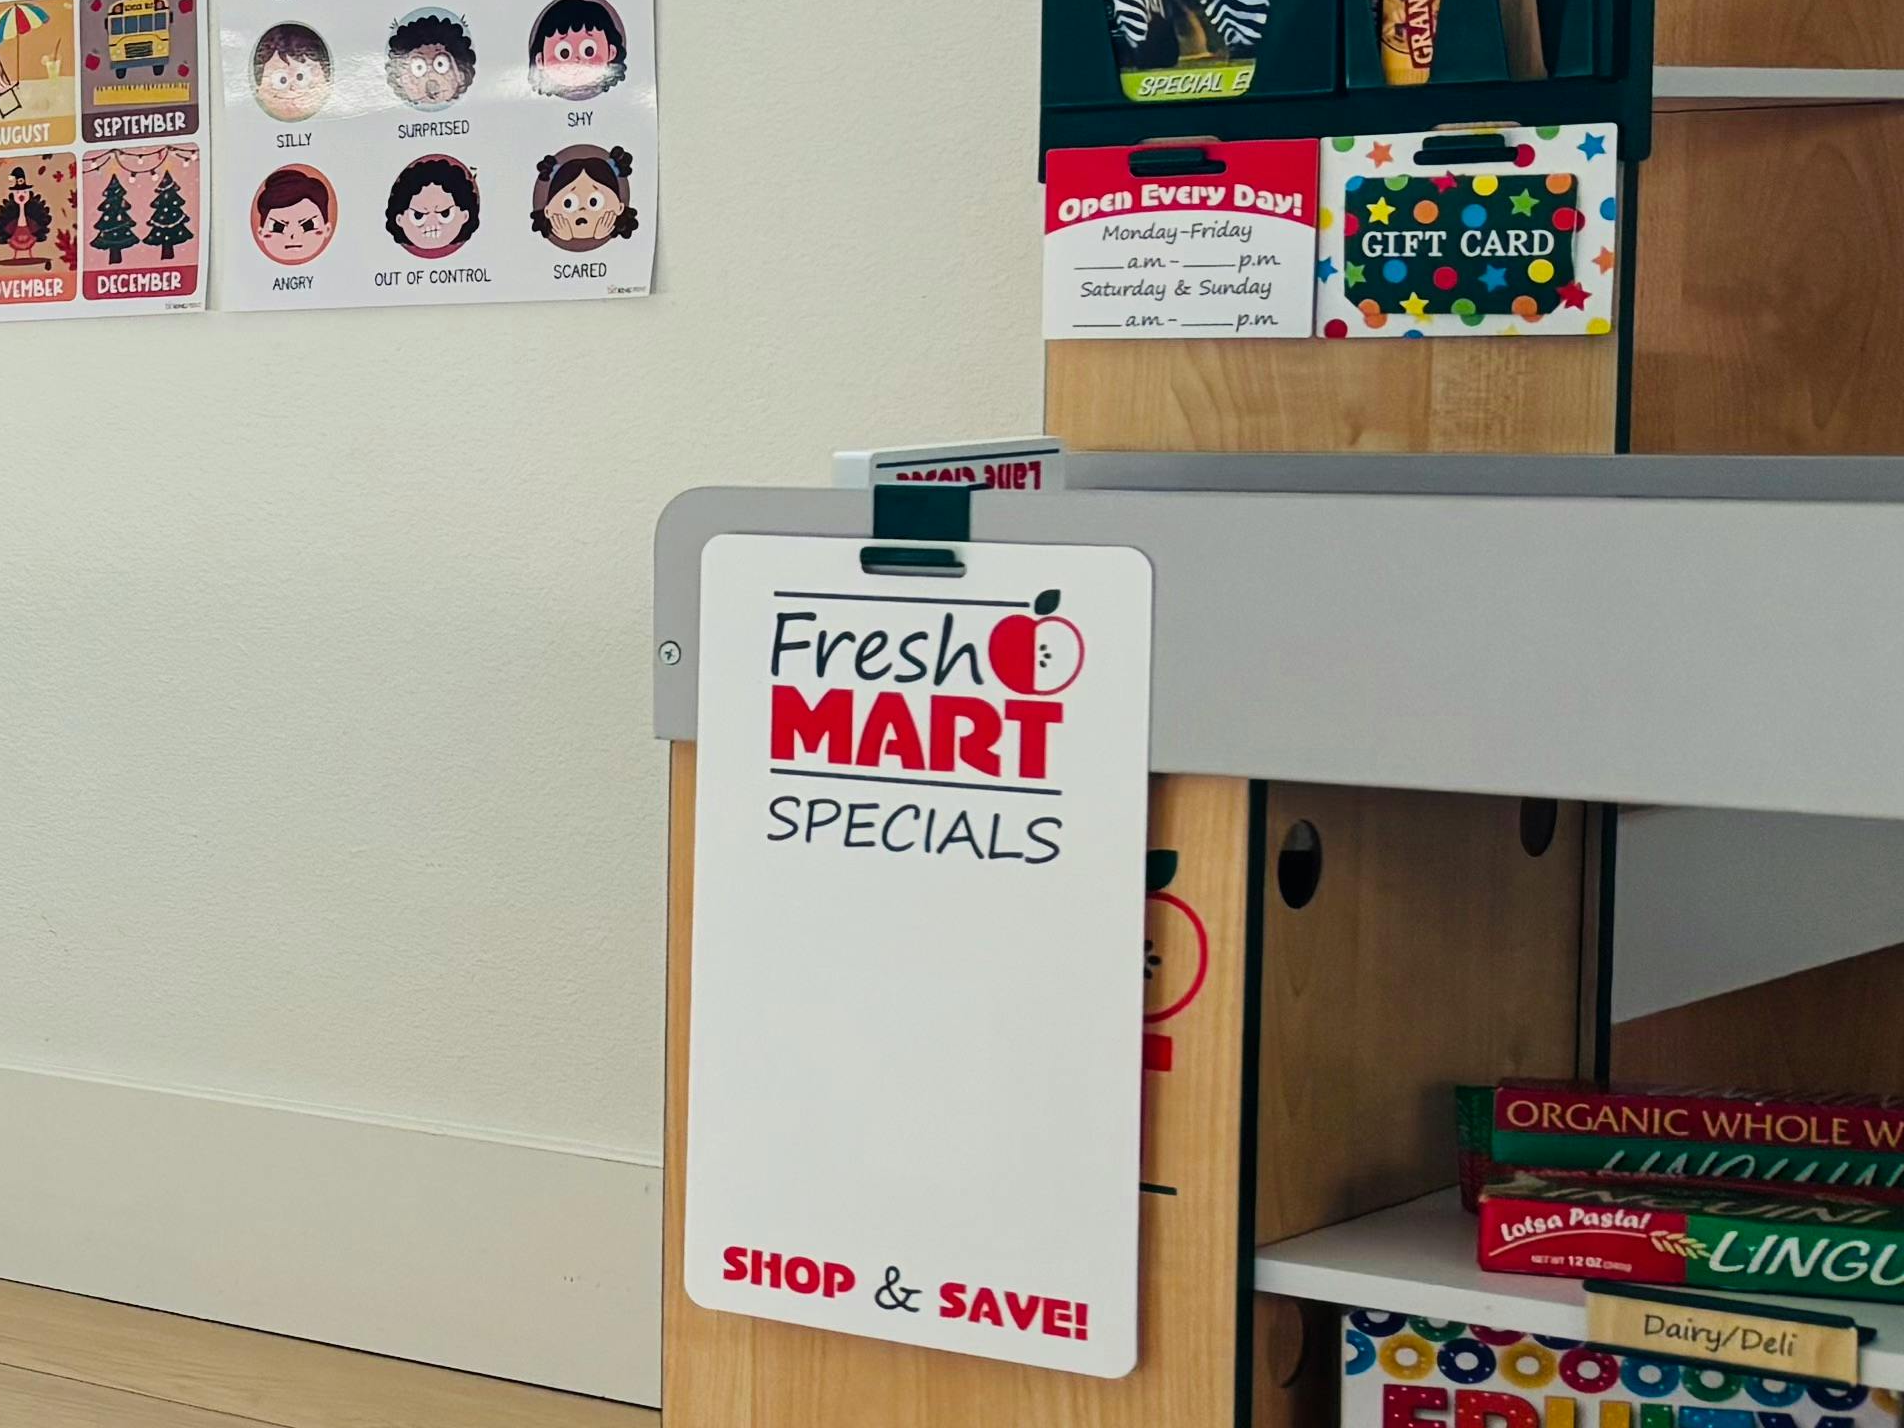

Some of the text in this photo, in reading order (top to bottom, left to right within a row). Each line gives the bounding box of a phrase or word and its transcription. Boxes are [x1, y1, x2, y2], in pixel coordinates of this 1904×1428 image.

[1138, 72, 1222, 97] SPECIAL
[94, 111, 187, 139] SEPTEMBER
[397, 120, 470, 140] SURPRISED
[567, 111, 593, 128] SHY
[277, 132, 313, 149] SILLY
[1058, 183, 1303, 222] Open Every Day!
[1102, 221, 1253, 245] Monday-Friday
[1361, 229, 1555, 258] GIFT CARD
[97, 271, 182, 295] DECEMBER
[272, 275, 314, 292] ANGRY
[374, 267, 492, 288] OUT OF CONTROL
[553, 263, 607, 281] SCARED
[1080, 277, 1272, 301] Saturday & Sunday
[770, 611, 984, 687] Fresh
[770, 684, 1064, 779] MART
[766, 795, 1063, 865] SPECIALS
[1506, 1100, 1689, 1137] ORGANIC
[1702, 1110, 1852, 1146] WHOLE
[1500, 1207, 1652, 1242] Lotsa Pasta!
[1568, 1256, 1584, 1267] 12
[1585, 1257, 1603, 1268] OZ
[722, 1245, 1089, 1341] SHOP & SAVE!
[1642, 1313, 1798, 1358] Dairy/Deli
